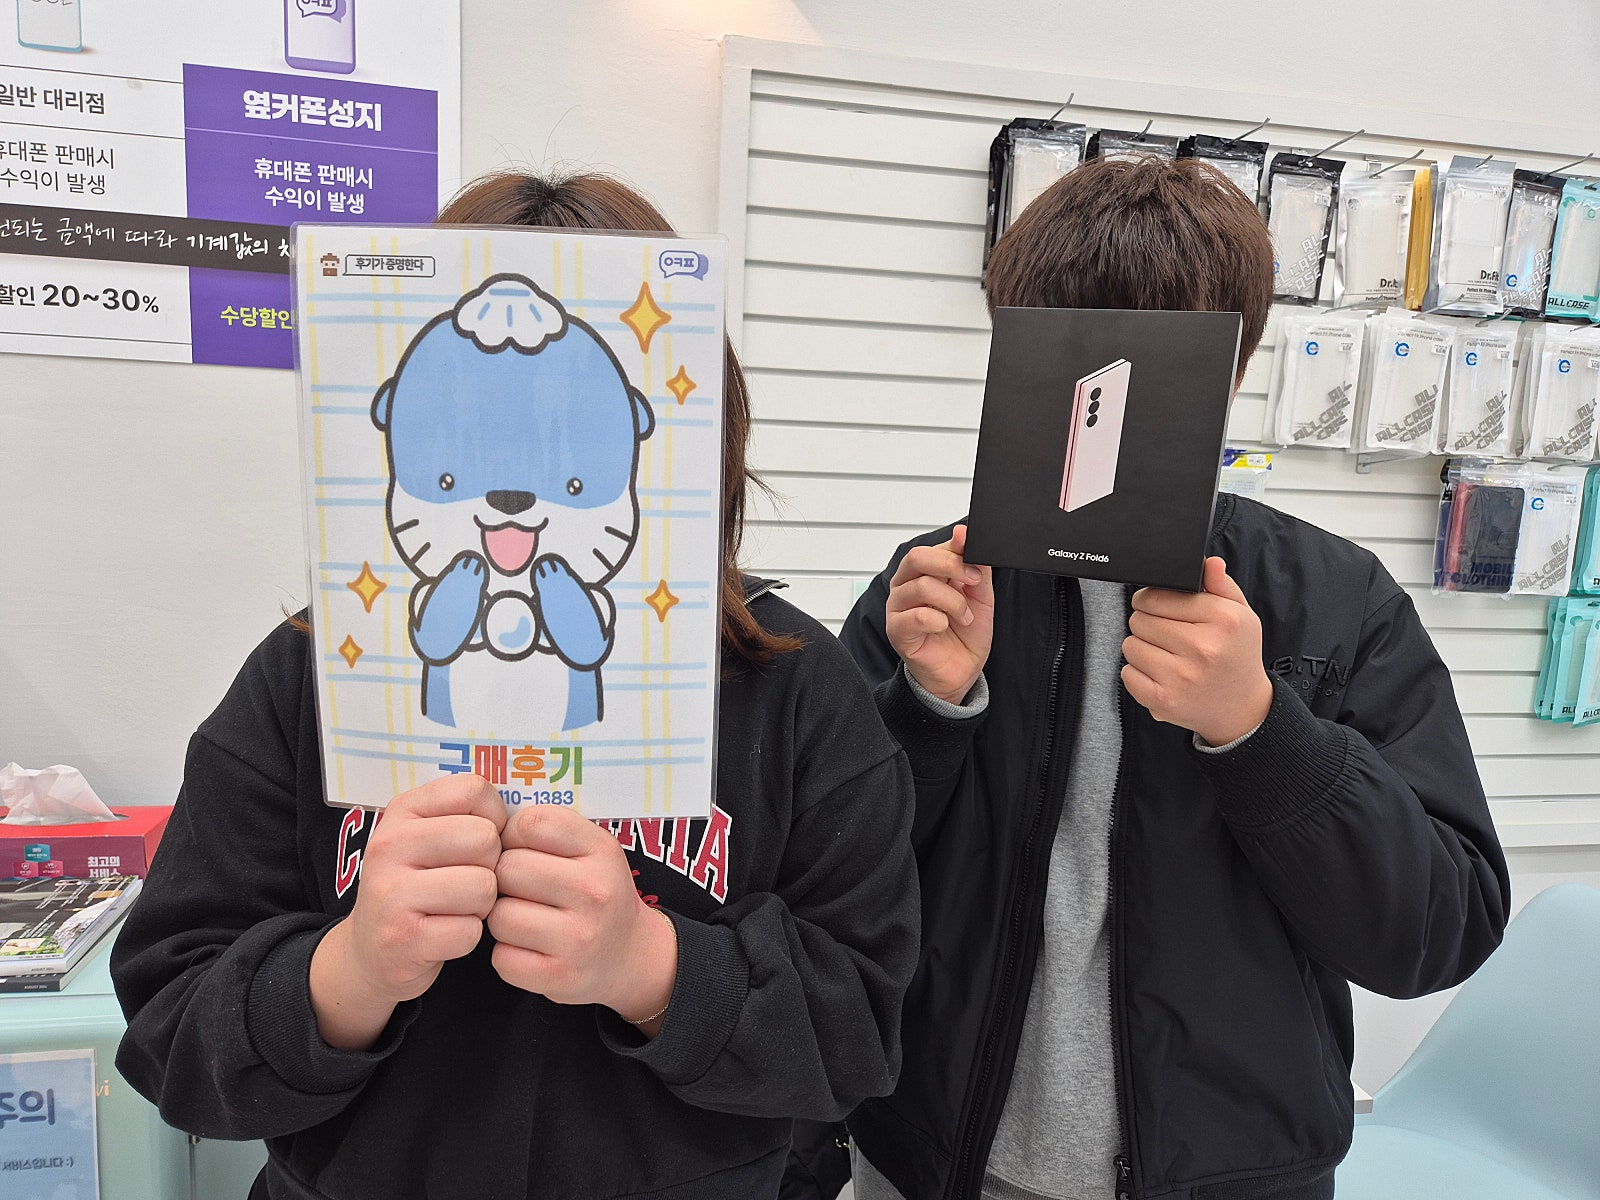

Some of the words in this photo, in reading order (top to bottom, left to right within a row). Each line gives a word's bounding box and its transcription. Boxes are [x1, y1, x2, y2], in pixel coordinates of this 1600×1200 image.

[43, 88, 105, 114] 대리점
[243, 90, 382, 131] 옆커폰성지
[55, 145, 114, 169] 판매시
[0, 168, 58, 192] 수익이
[67, 173, 105, 195] 발생
[254, 157, 312, 183] 휴대폰
[317, 164, 373, 189] 판매시
[264, 186, 321, 210] 수익이
[327, 191, 364, 214] 발생
[57, 217, 115, 246] 금액에
[125, 230, 178, 249] 따라
[186, 232, 268, 260] 기계값의
[355, 257, 384, 270] 후기가
[385, 258, 424, 271] 증명한다
[42, 283, 160, 313] 20~30%
[1547, 297, 1590, 310] ALLCASE
[1048, 548, 1079, 561] Galaxy
[1079, 552, 1086, 560] Z
[1086, 553, 1110, 563] Fold6
[1450, 572, 1514, 587] CLOTHIN
[1470, 562, 1514, 575] MOBIL
[438, 742, 583, 787] 구매후기
[87, 856, 121, 868] 최고의
[2, 1156, 64, 1172] 서비스입니다
